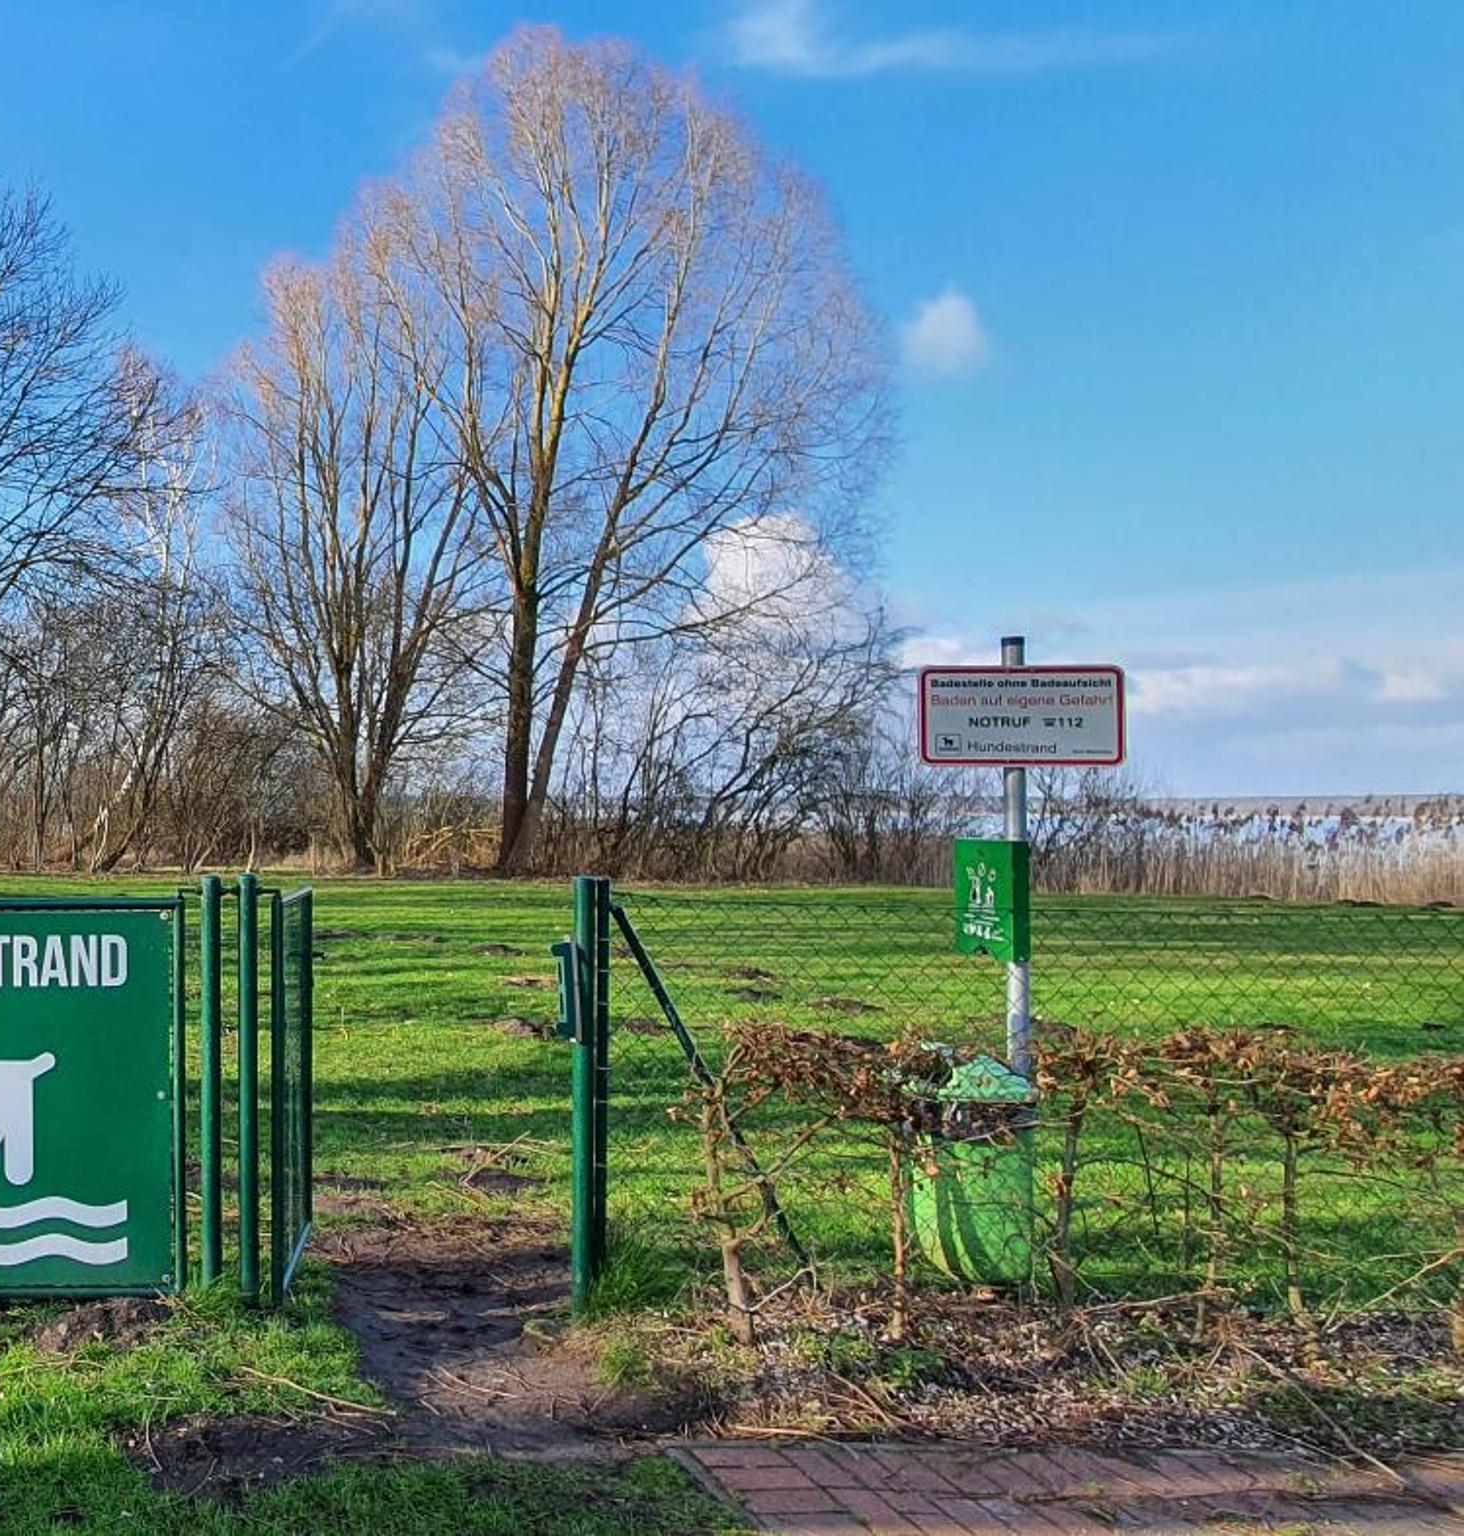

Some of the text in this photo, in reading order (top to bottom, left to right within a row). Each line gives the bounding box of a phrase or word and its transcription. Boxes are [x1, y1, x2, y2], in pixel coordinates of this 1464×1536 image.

[930, 678, 1112, 688] Badestelle ohne Badeaufsicht
[930, 694, 977, 706] Baden
[980, 694, 1003, 706] auf
[1007, 694, 1055, 709] eigene
[968, 716, 1031, 728] NOTRUF
[967, 739, 1057, 754] Hundestrand
